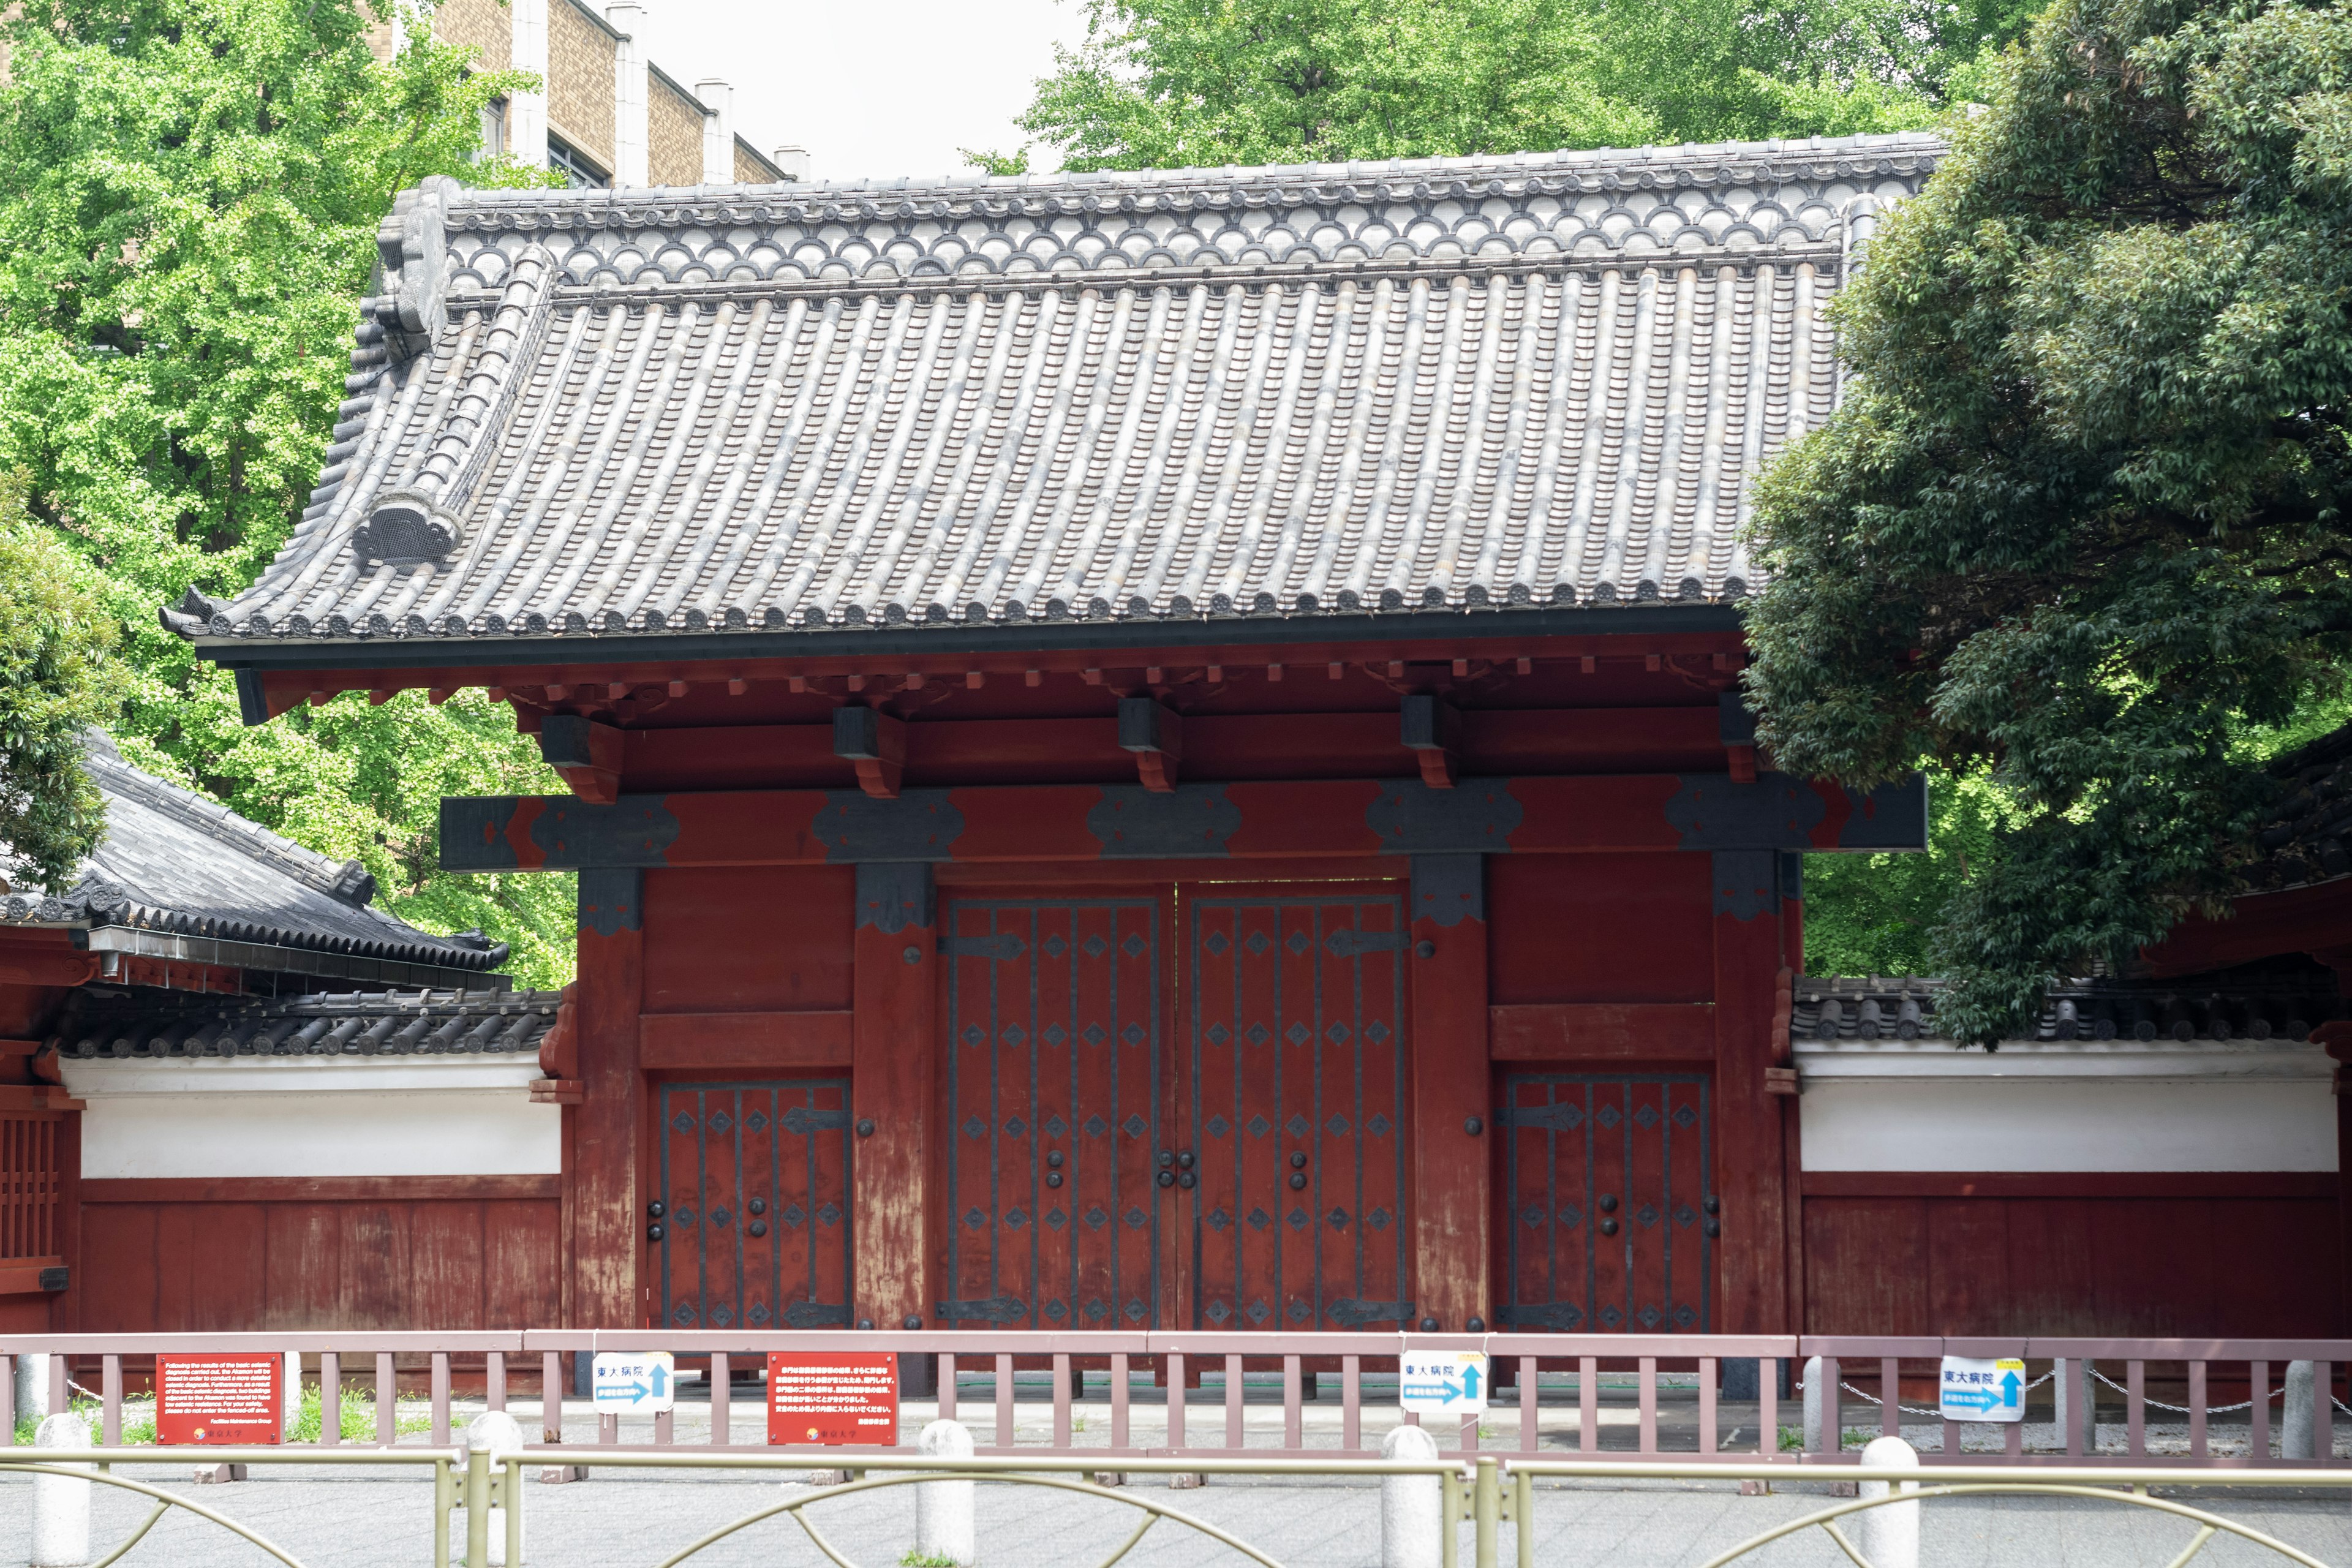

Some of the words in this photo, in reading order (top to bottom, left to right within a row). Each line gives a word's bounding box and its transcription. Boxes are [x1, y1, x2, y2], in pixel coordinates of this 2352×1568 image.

[598, 1366, 643, 1378] 東大病院
[1406, 1365, 1454, 1376] 東大病院
[1944, 1371, 1994, 1384] 東大病院
